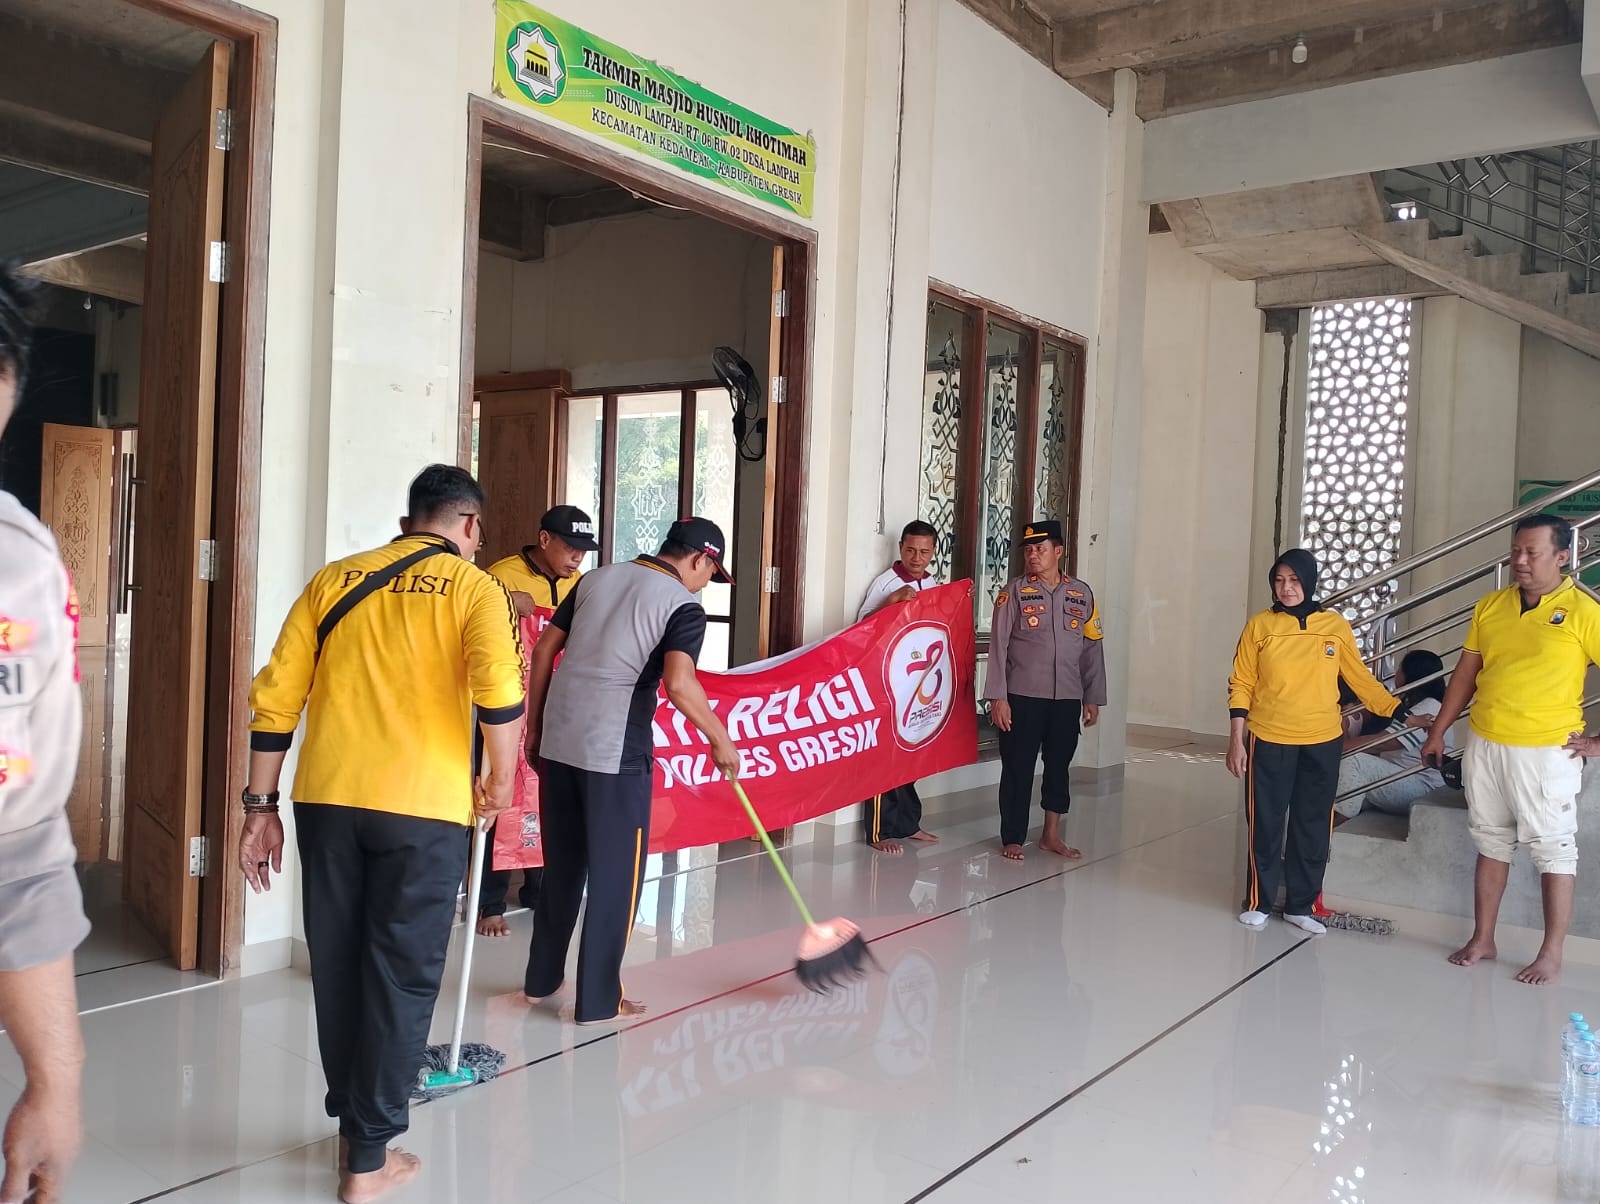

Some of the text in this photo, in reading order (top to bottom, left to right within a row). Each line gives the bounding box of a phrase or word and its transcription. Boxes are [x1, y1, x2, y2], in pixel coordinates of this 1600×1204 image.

[582, 47, 807, 166] TAKMIR MASJID HUSNUL KHOTIMAH
[606, 88, 642, 116] DUSUN
[644, 106, 684, 133] LAMPAH
[685, 123, 699, 142] RT
[714, 138, 728, 154] RW
[730, 144, 741, 160] 02
[742, 150, 765, 169] DESA
[766, 160, 800, 185] LAMPAH
[591, 107, 656, 146] KECAMATAN
[659, 137, 710, 170] KEDAMEAN
[717, 161, 770, 192] KABUPATEN
[771, 182, 802, 205] GRESIK
[727, 667, 878, 742] RELIGI
[779, 717, 880, 773] GRESIK
